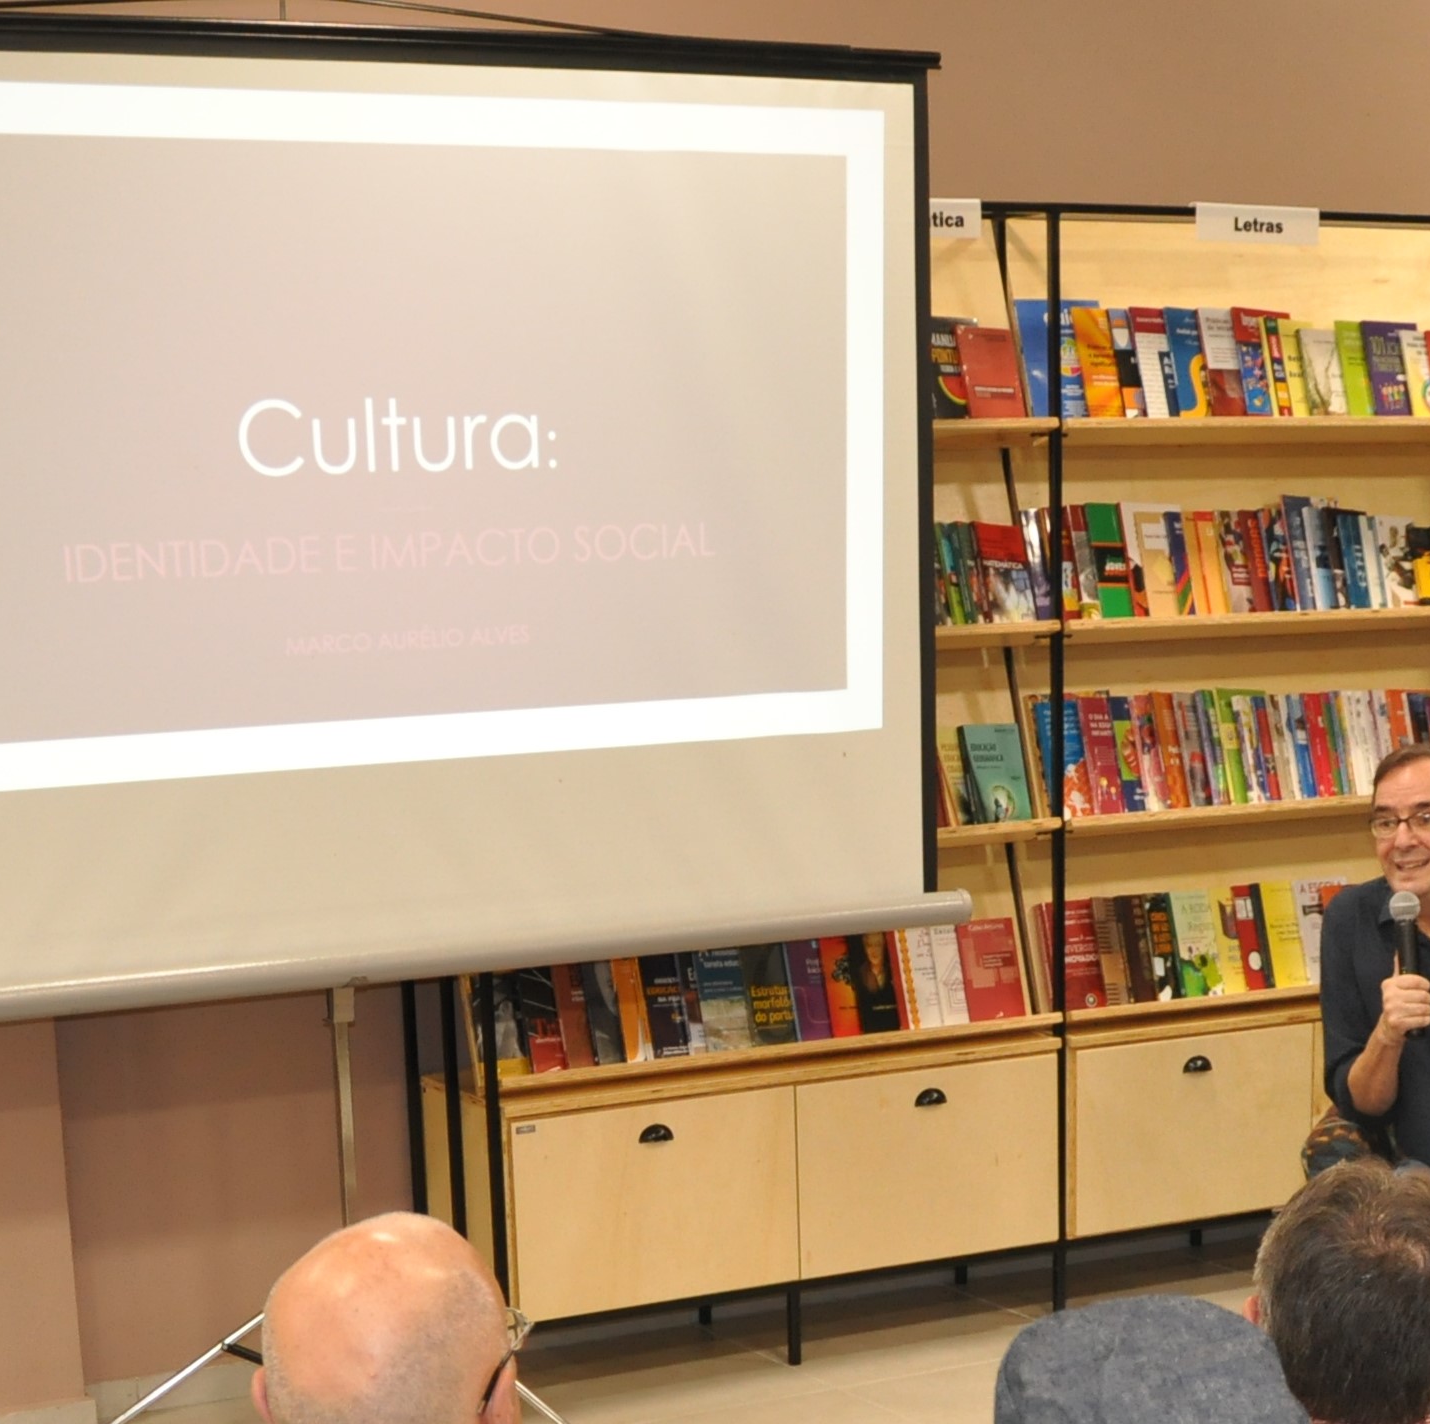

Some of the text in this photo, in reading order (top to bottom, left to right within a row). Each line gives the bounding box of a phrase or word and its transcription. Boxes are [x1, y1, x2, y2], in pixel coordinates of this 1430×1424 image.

[1234, 216, 1284, 235] Letras
[237, 396, 560, 478] Cultura:
[63, 522, 717, 583] IDENTIDADE E IMPACTO SOCIAL
[284, 624, 531, 656] MARCO AURÉLIO ALVES
[755, 1011, 767, 1022] do
